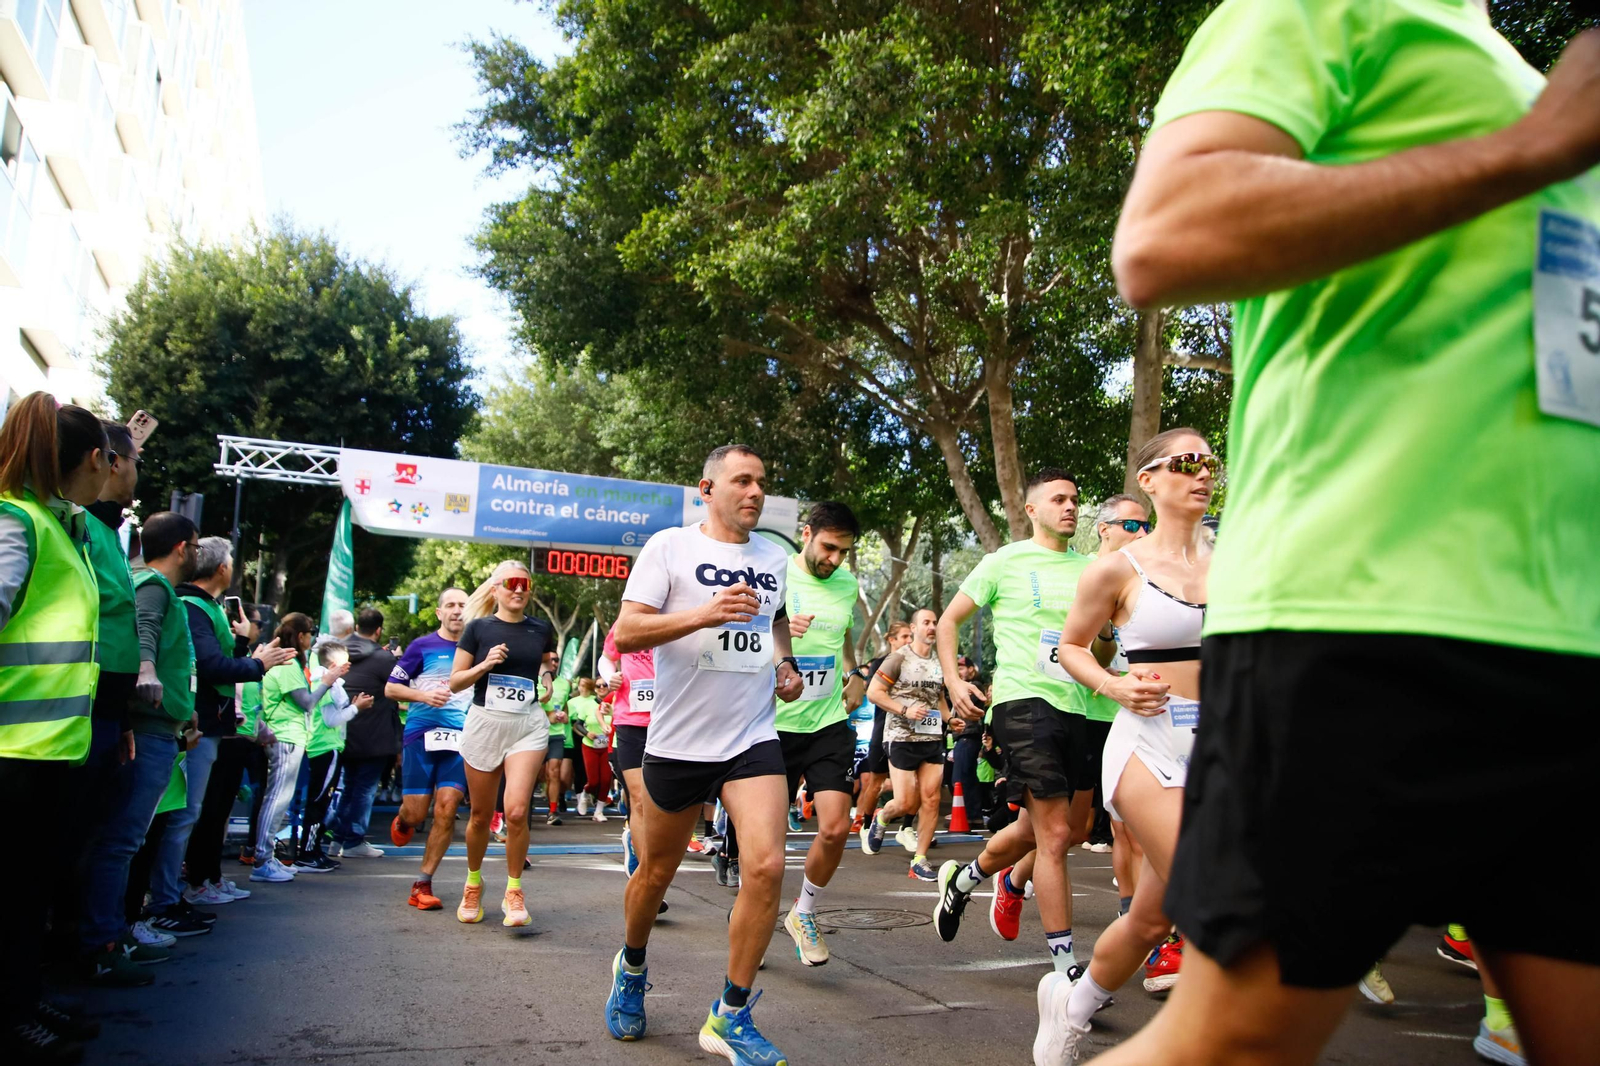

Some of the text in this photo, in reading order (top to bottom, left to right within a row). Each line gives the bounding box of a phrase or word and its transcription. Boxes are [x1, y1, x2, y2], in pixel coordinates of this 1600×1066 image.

[492, 474, 673, 507] Almería en marcha
[490, 498, 650, 525] contra el cáncer
[695, 563, 778, 592] Cooke
[718, 630, 762, 653] 108
[495, 686, 526, 702] 326
[921, 718, 938, 726] 283
[433, 731, 457, 742] 271
